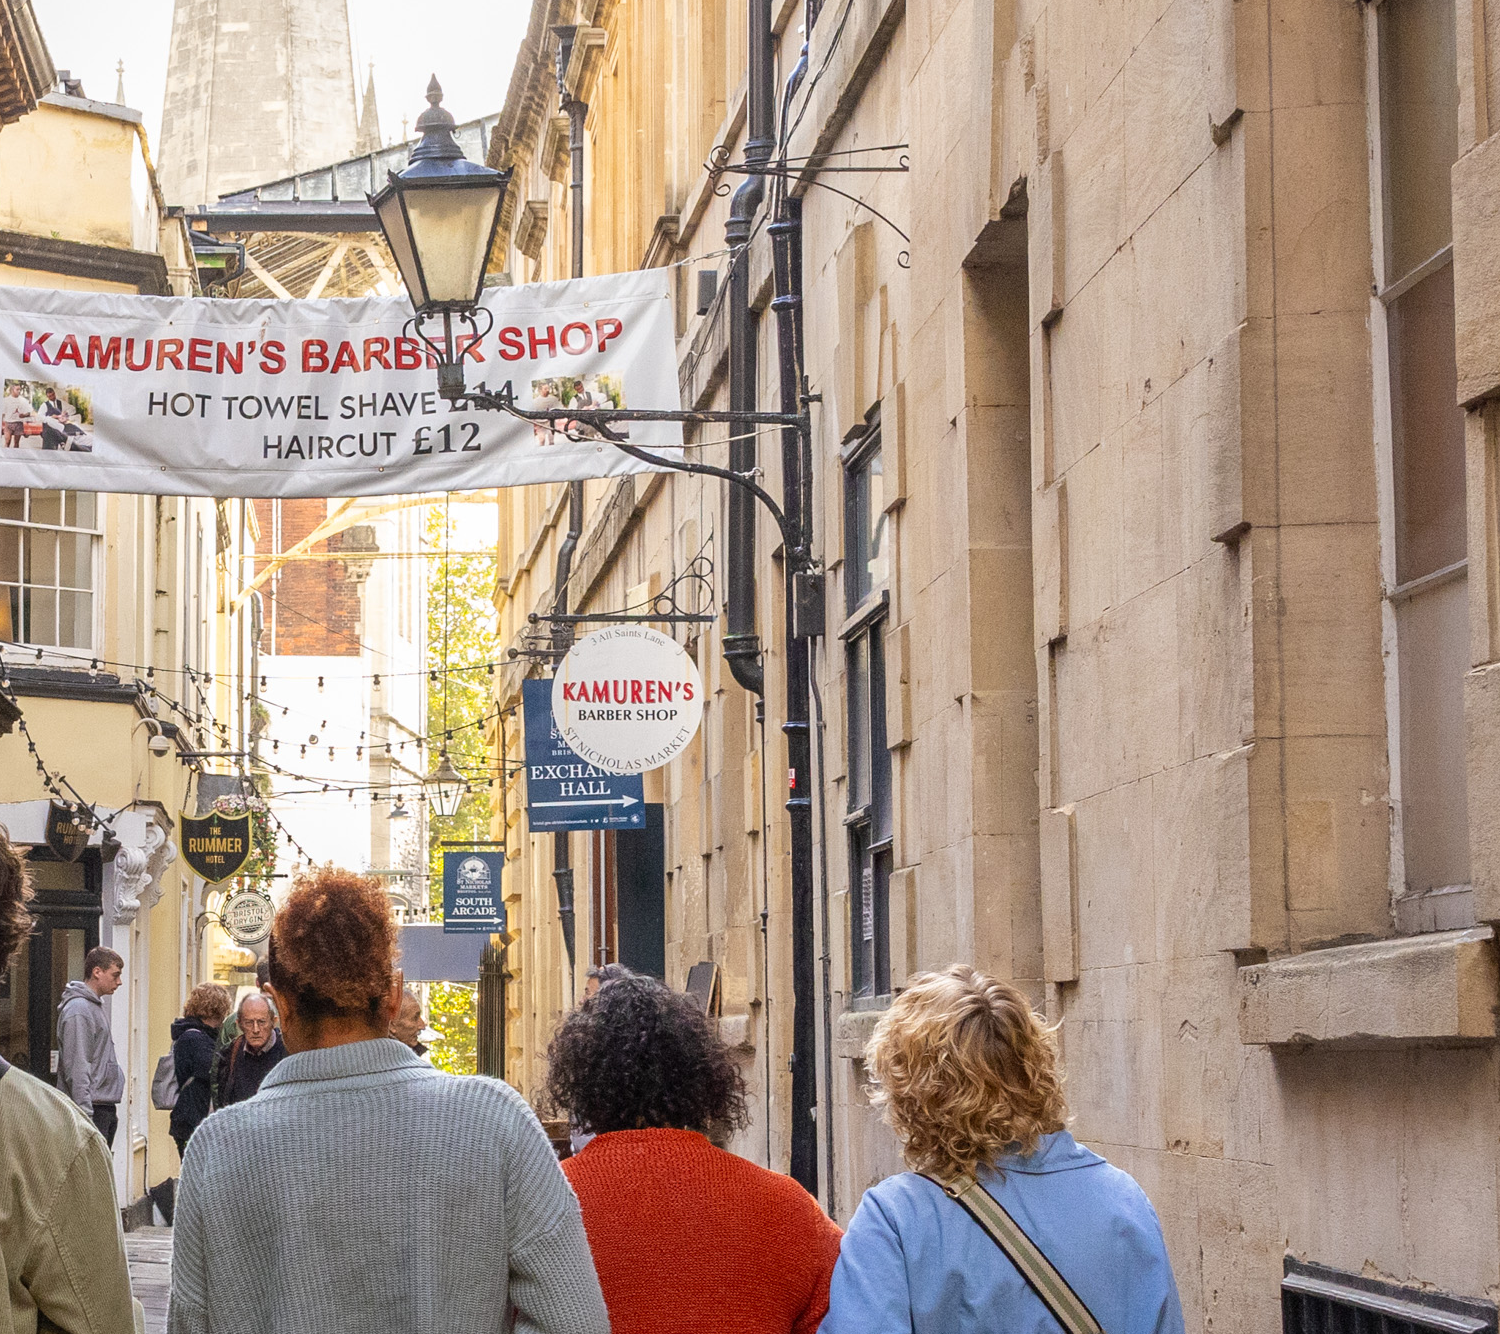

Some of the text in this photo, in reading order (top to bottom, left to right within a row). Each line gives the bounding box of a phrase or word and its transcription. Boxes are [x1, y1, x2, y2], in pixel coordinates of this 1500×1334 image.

[23, 317, 623, 374] KAMUREN'S BARBER SHOP
[148, 391, 211, 418] HOT
[222, 395, 329, 420] TOWEL
[340, 391, 436, 419] SHAVE
[263, 422, 482, 459] HAIRCUT £12
[591, 629, 665, 646] 3 All Saints Lane
[563, 679, 694, 705] KAMUREN'S
[578, 709, 678, 721] BARBER SHOP
[564, 725, 691, 770] ST NICHOLAS MARKET
[531, 764, 638, 780] EXCHAN
[560, 781, 611, 796] HALL
[209, 827, 221, 835] THE
[189, 837, 242, 852] RUMMER
[205, 855, 225, 864] HOTEL
[455, 897, 492, 906] SOUTH
[233, 908, 264, 918] BRISTOL
[452, 907, 496, 915] ARCADE
